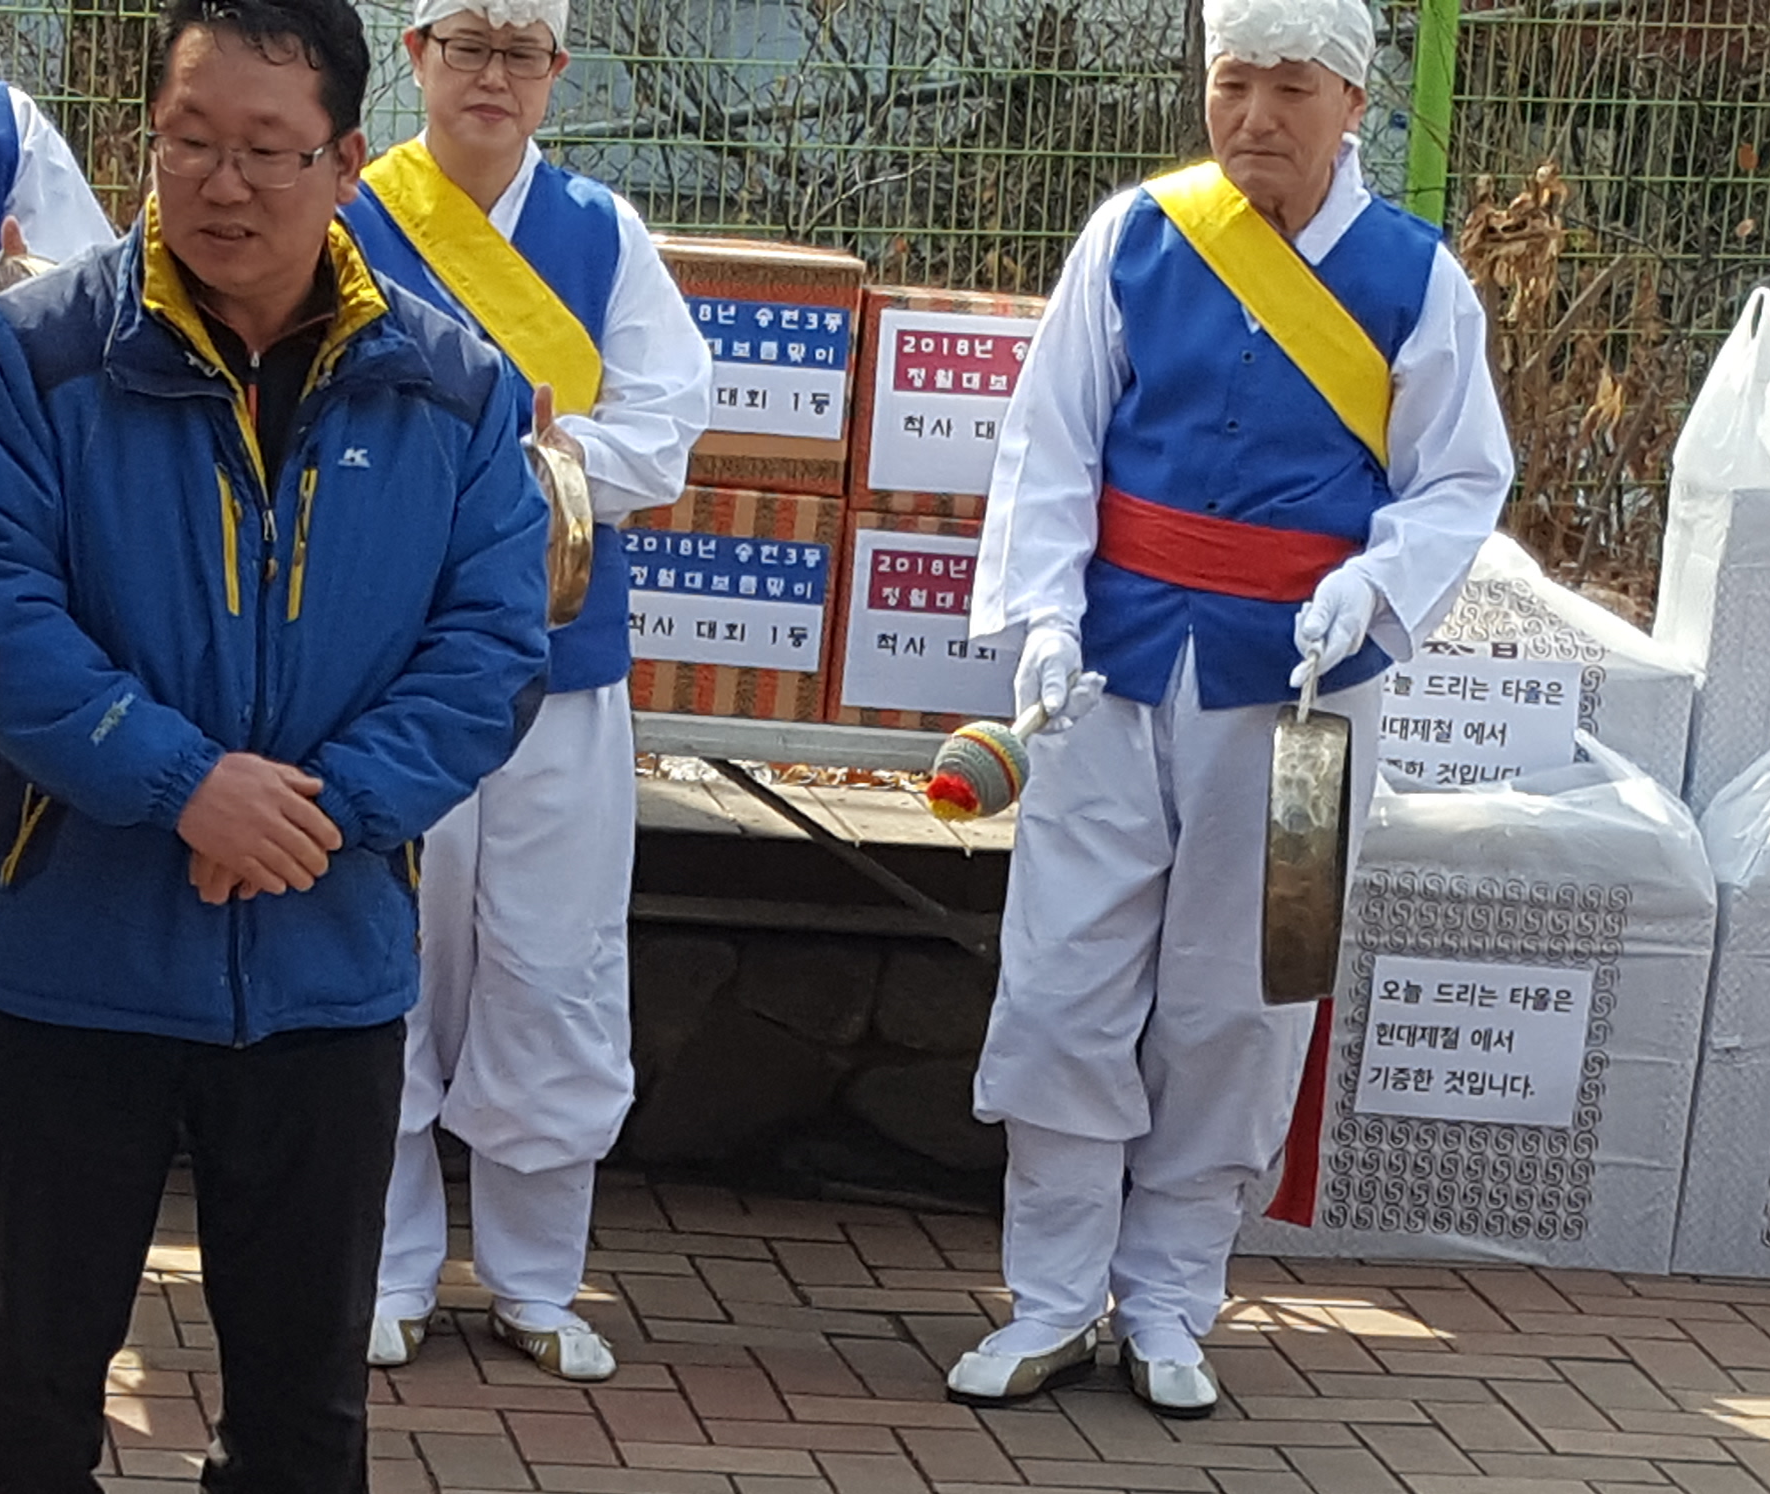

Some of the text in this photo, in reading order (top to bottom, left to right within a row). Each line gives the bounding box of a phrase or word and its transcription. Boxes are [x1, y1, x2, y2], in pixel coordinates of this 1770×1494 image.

[686, 303, 842, 333] 8년 송현3동
[706, 338, 833, 364] 대보름맞이
[902, 335, 993, 358] 2018년
[907, 368, 1008, 390] 정월대보
[717, 388, 830, 415] 대회 1등
[903, 416, 995, 440] 척사 대
[625, 534, 716, 559] 2018년
[877, 555, 967, 578] 2018년
[696, 621, 745, 642] 대회
[771, 626, 808, 648] 1등
[877, 633, 925, 656] 척사
[1384, 672, 1412, 696] 늘
[1424, 675, 1490, 701] 드리는
[1464, 722, 1507, 746] 에서
[1379, 979, 1423, 1004] 오늘
[1432, 983, 1498, 1007] 드리는
[1470, 1028, 1514, 1053] 에서
[1367, 1066, 1535, 1099] 기증한 것입니다.
